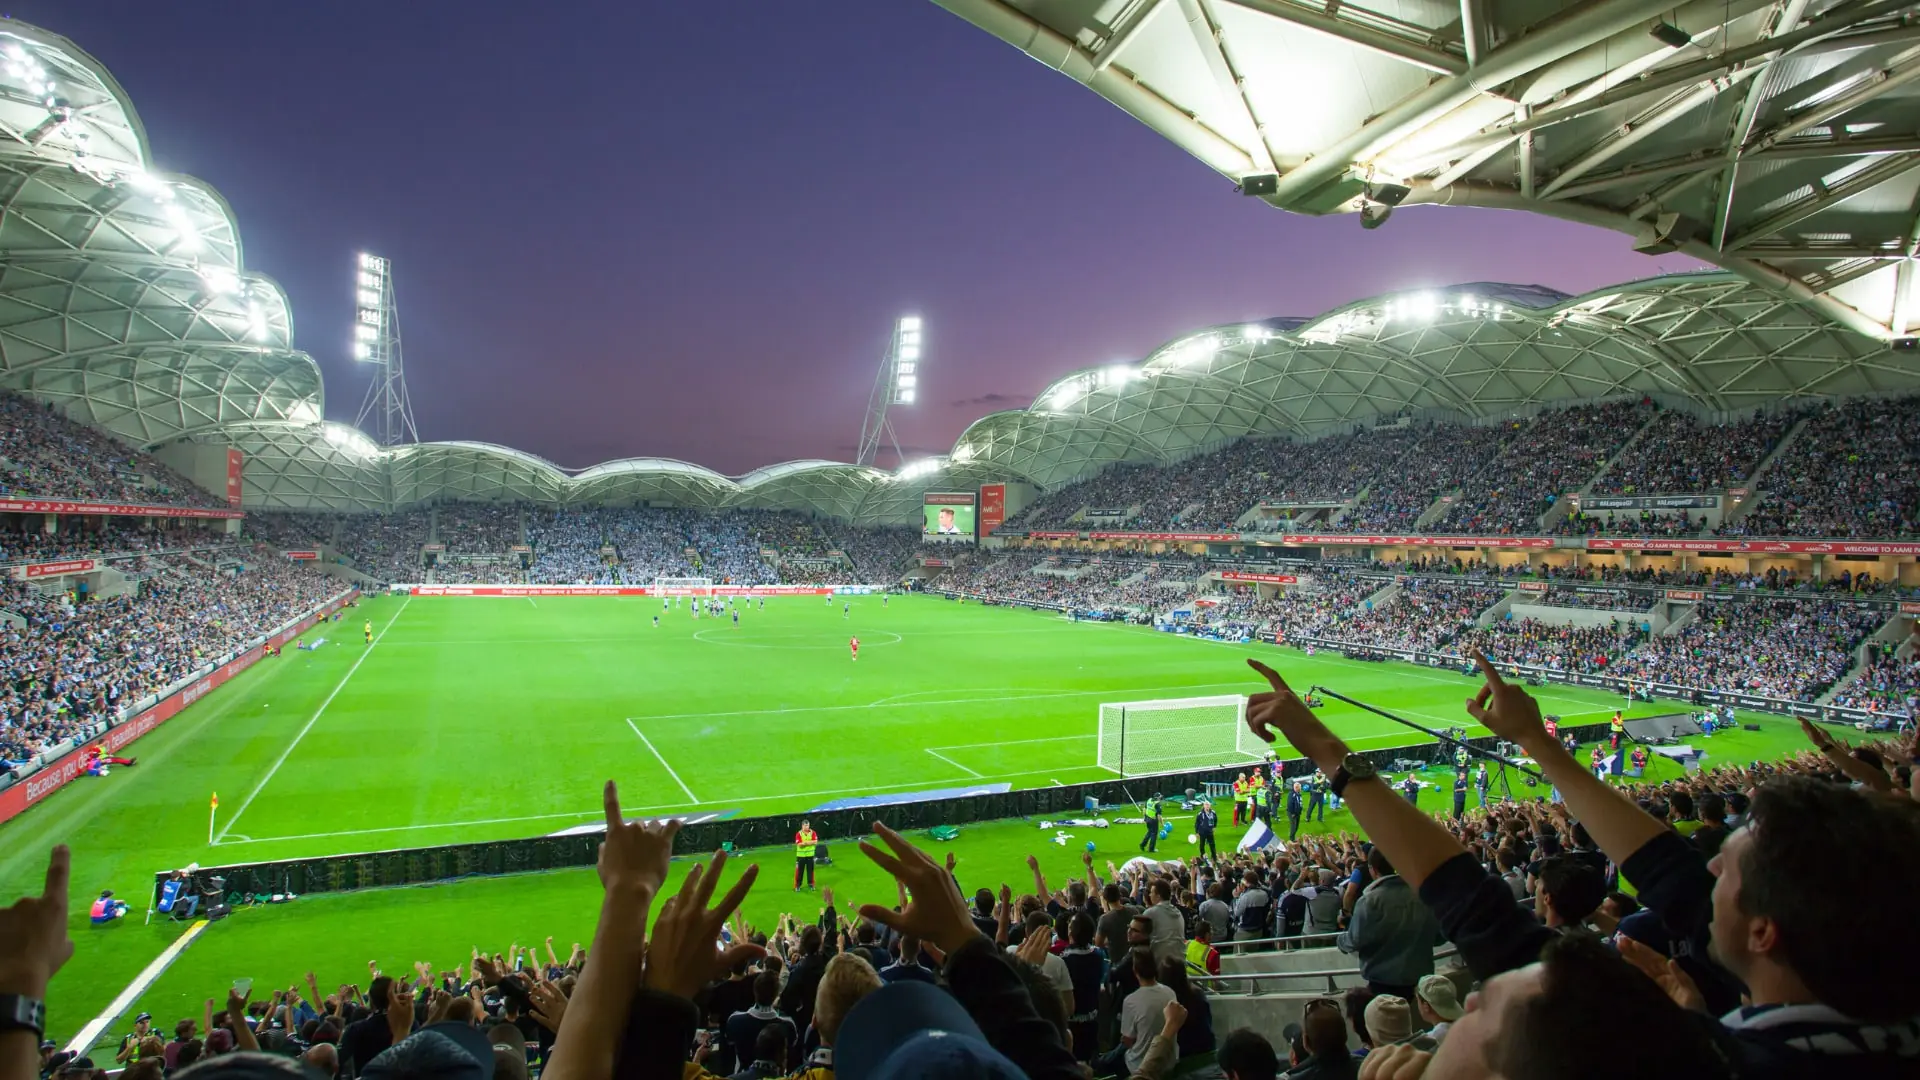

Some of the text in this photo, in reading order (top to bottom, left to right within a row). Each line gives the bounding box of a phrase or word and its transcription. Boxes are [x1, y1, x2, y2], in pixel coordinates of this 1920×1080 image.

[27, 769, 61, 801] Because
[62, 760, 77, 783] you
[112, 720, 137, 749] beautiful
[138, 713, 155, 737] picture
